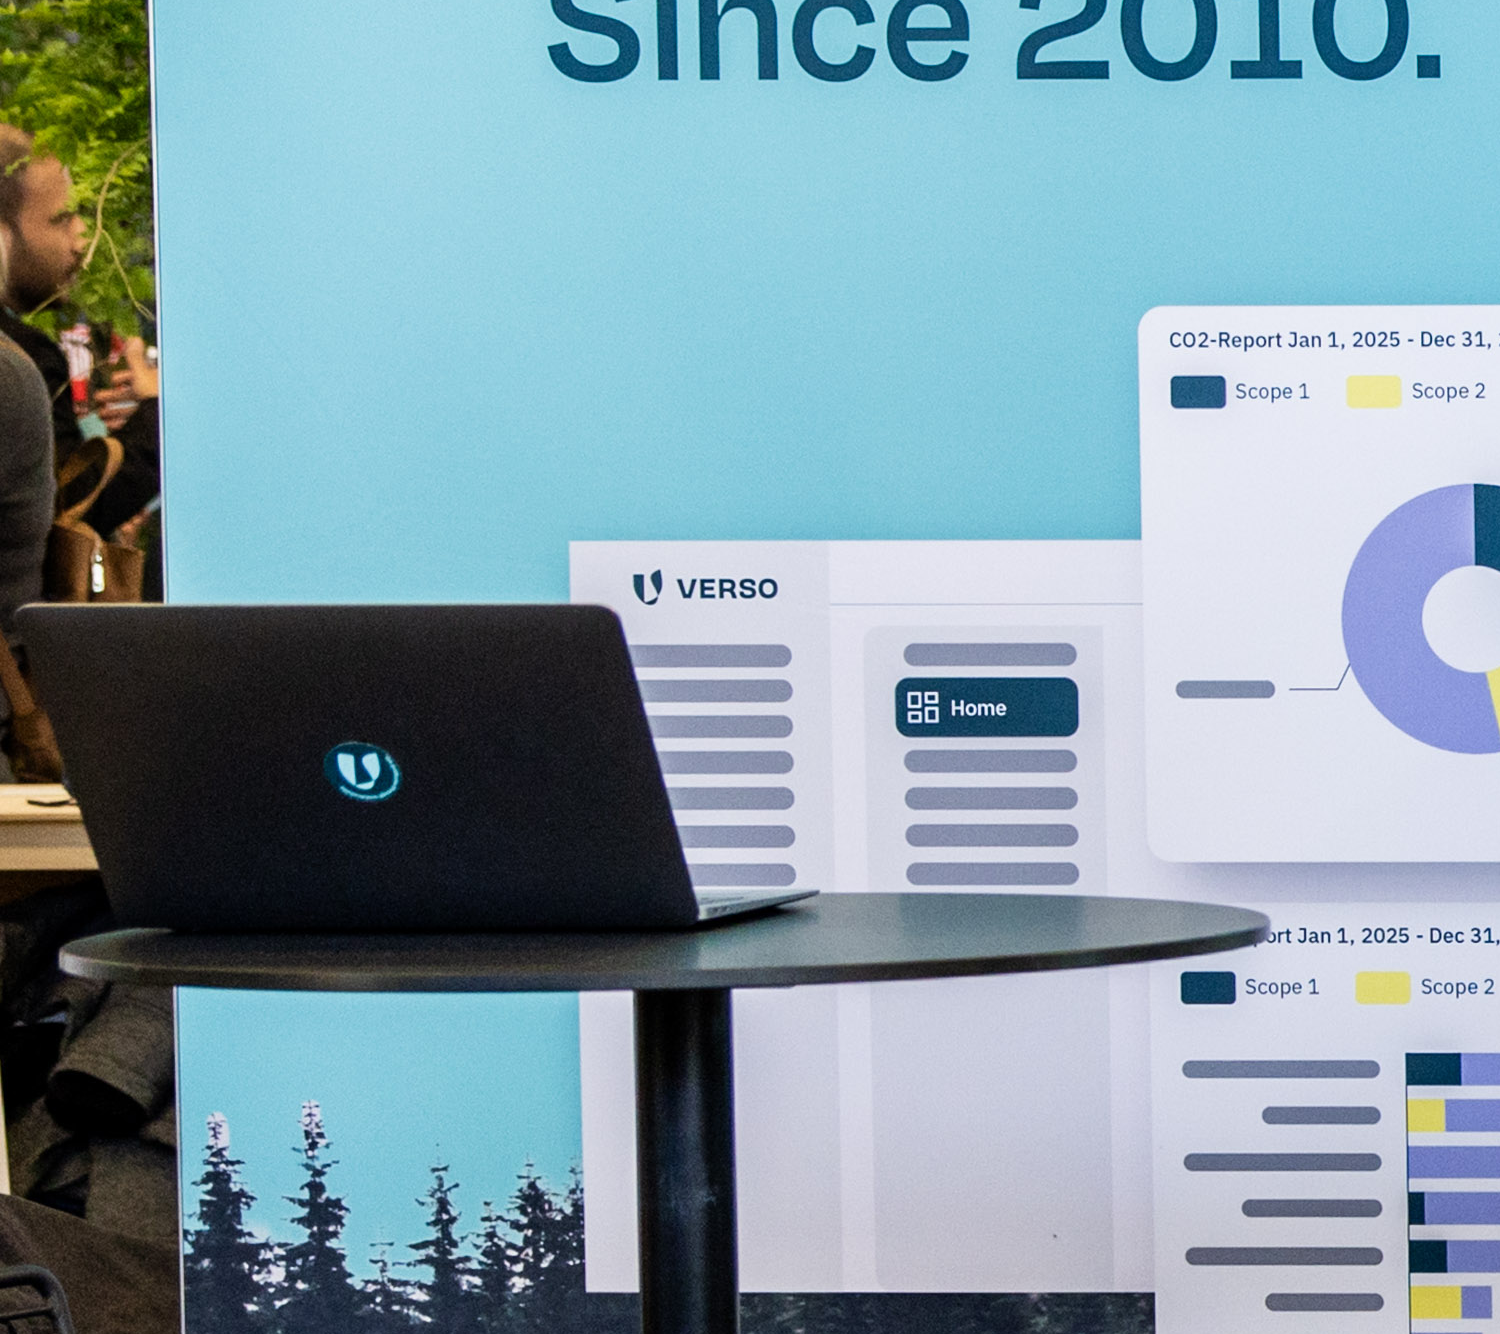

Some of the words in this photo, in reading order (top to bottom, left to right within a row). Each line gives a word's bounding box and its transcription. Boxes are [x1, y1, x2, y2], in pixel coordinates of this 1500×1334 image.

[1170, 332, 1281, 352] CO2-Report
[1288, 332, 1321, 347] Jan
[1328, 332, 1345, 349] 1,
[1353, 331, 1400, 347] 2025
[1421, 331, 1455, 347] Dec
[1462, 331, 1491, 349] 31,
[1236, 383, 1292, 403] Scope
[1300, 383, 1309, 399] 1
[1413, 383, 1469, 403] Scope
[1475, 383, 1485, 398] 2
[677, 579, 778, 598] VERSO
[951, 700, 1007, 716] Home
[1298, 928, 1331, 943] Jan
[1338, 928, 1354, 945] 1,
[1362, 928, 1409, 943] 2025
[1430, 928, 1464, 943] Dec
[1471, 928, 1500, 945] 31,
[1246, 979, 1302, 998] Scope
[1309, 979, 1319, 995] 1
[1422, 979, 1478, 998] Scope
[1484, 979, 1494, 994] 2
